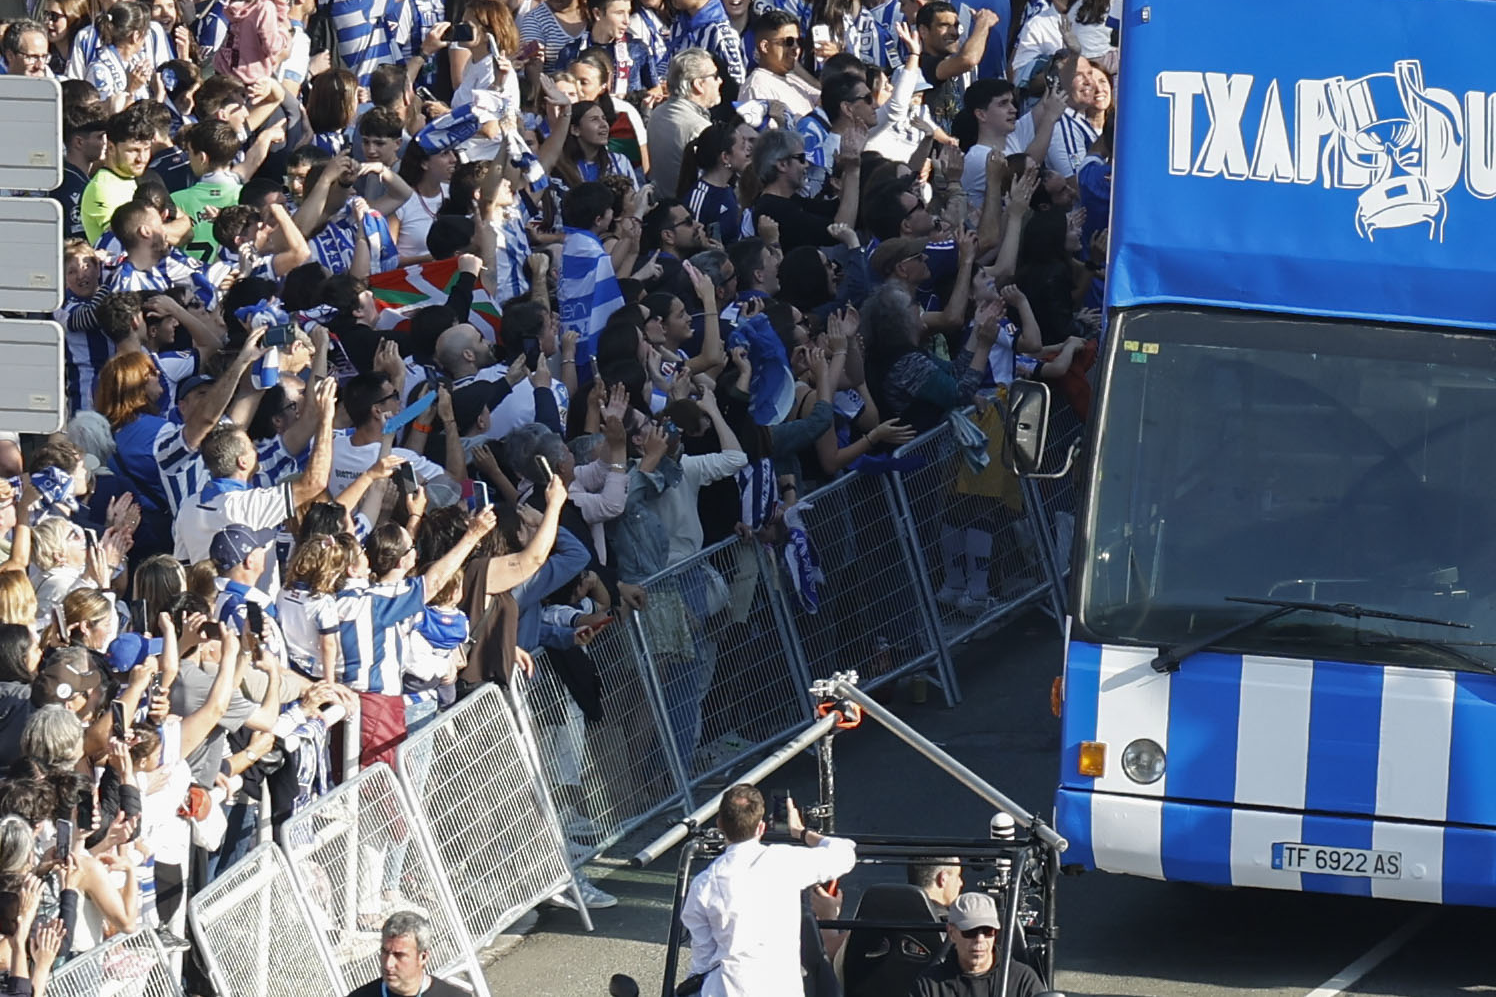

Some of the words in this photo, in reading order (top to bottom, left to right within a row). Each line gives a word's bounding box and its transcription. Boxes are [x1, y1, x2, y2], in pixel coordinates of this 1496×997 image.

[1285, 846, 1310, 868] TF
[1315, 849, 1368, 873] 6922
[1373, 854, 1400, 875] AS
